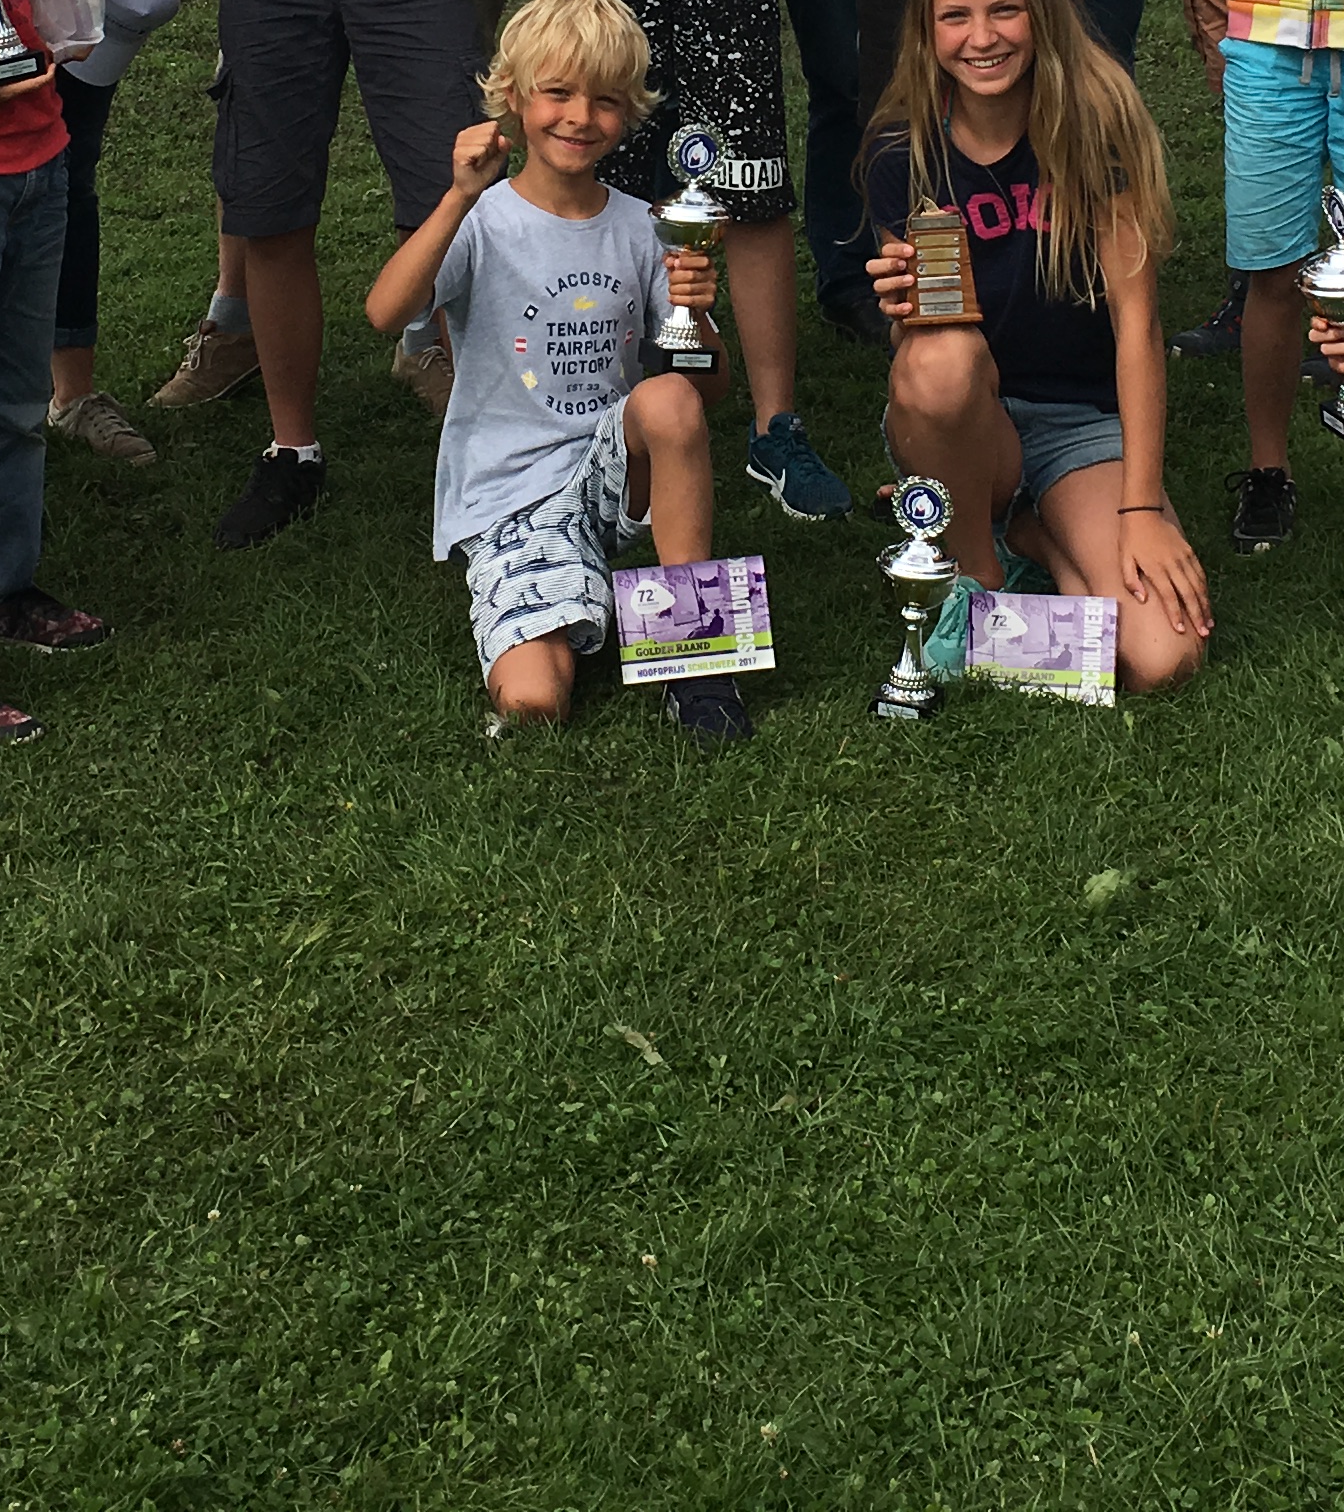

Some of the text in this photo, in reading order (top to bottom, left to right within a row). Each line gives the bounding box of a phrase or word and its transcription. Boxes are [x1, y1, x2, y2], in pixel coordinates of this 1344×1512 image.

[544, 271, 622, 298] LACOSTE
[546, 318, 620, 337] TENACITY
[546, 338, 618, 357] FAIRPLAY
[550, 356, 614, 376] VICTORY
[586, 382, 600, 391] 33
[727, 556, 756, 655] SCHILDWEEK
[991, 614, 1007, 627] 72
[635, 641, 711, 657] GOLDEN RAAND
[637, 657, 757, 678] HOOFDPRIJS SCHILDWEEK 2017
